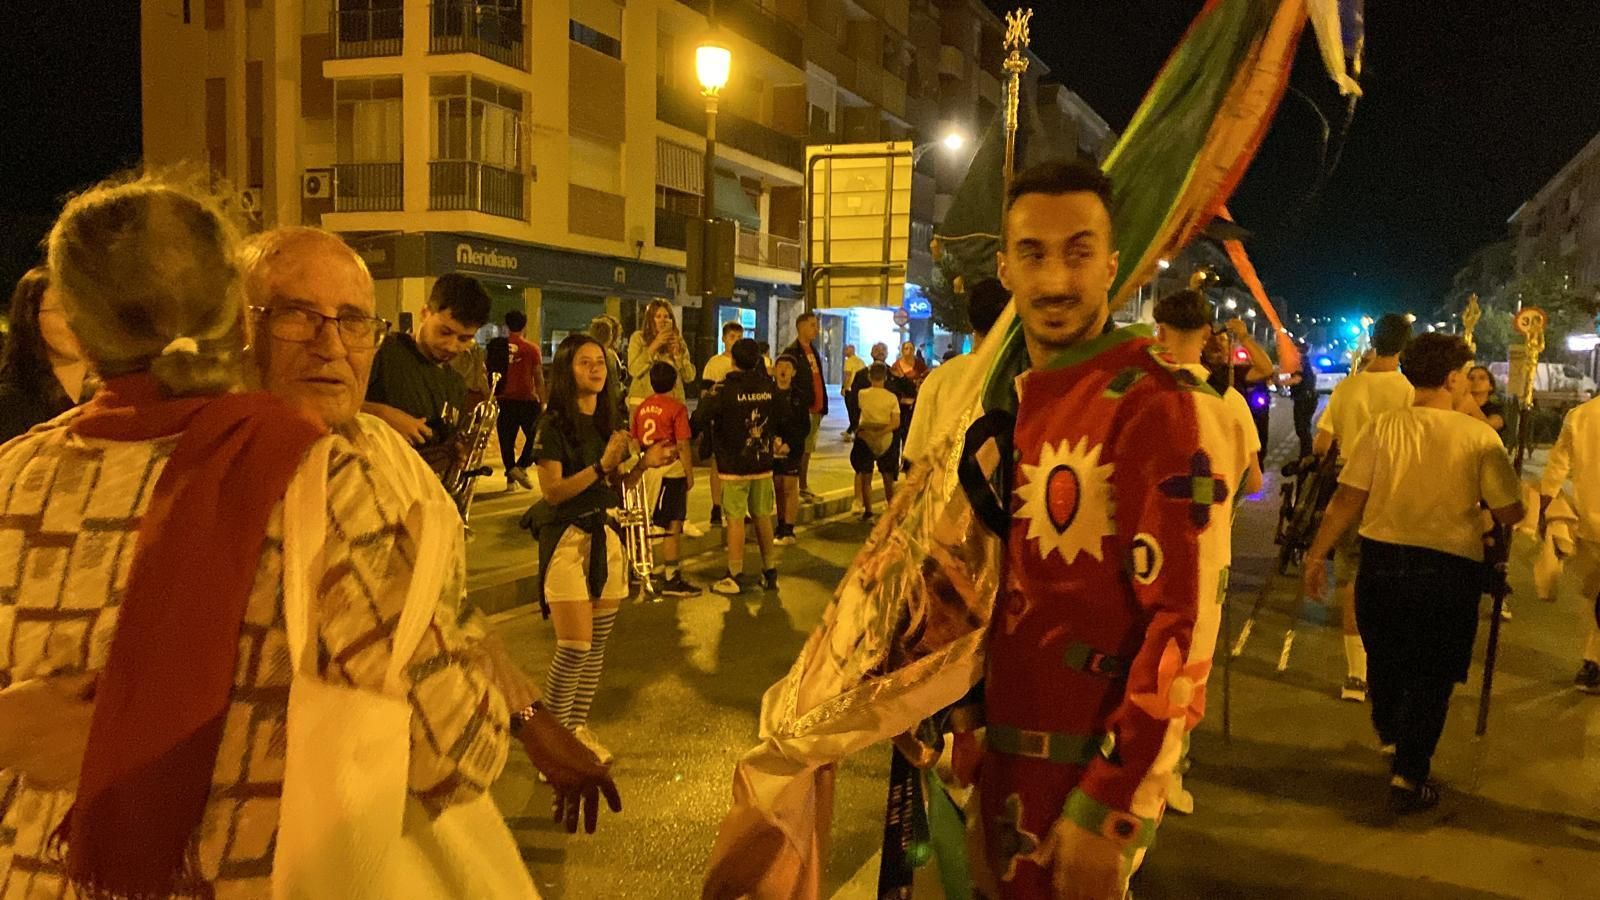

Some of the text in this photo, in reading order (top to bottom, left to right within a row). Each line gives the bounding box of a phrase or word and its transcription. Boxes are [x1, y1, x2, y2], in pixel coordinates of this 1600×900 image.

[737, 391, 772, 401] LA LEGIÓN
[643, 419, 656, 445] 2
